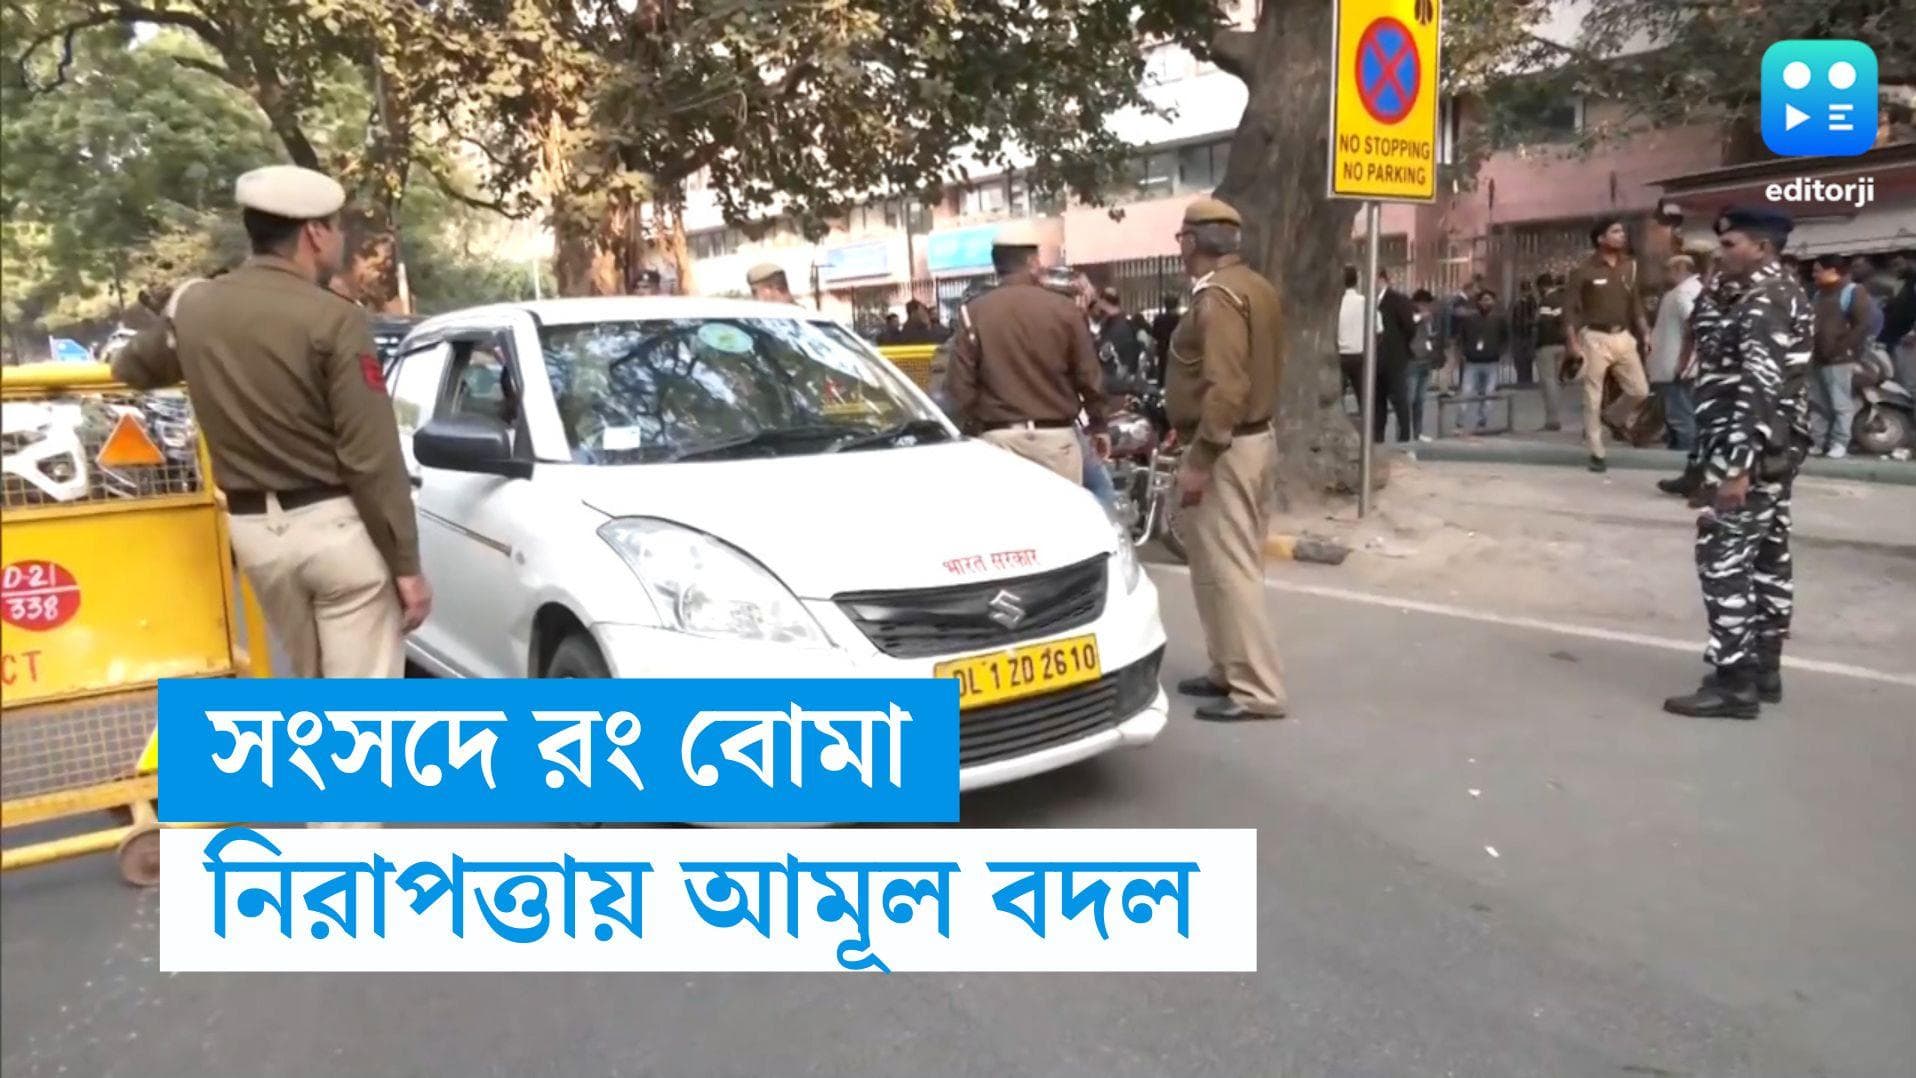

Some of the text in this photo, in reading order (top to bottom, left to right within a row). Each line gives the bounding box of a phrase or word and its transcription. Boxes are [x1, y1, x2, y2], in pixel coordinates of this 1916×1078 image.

[1340, 133, 1430, 160] NO STOPPING
[1343, 162, 1426, 185] NO PARKING
[943, 549, 1037, 575] भारत सरकार
[6, 594, 59, 620] 338
[1041, 643, 1096, 681] 2610
